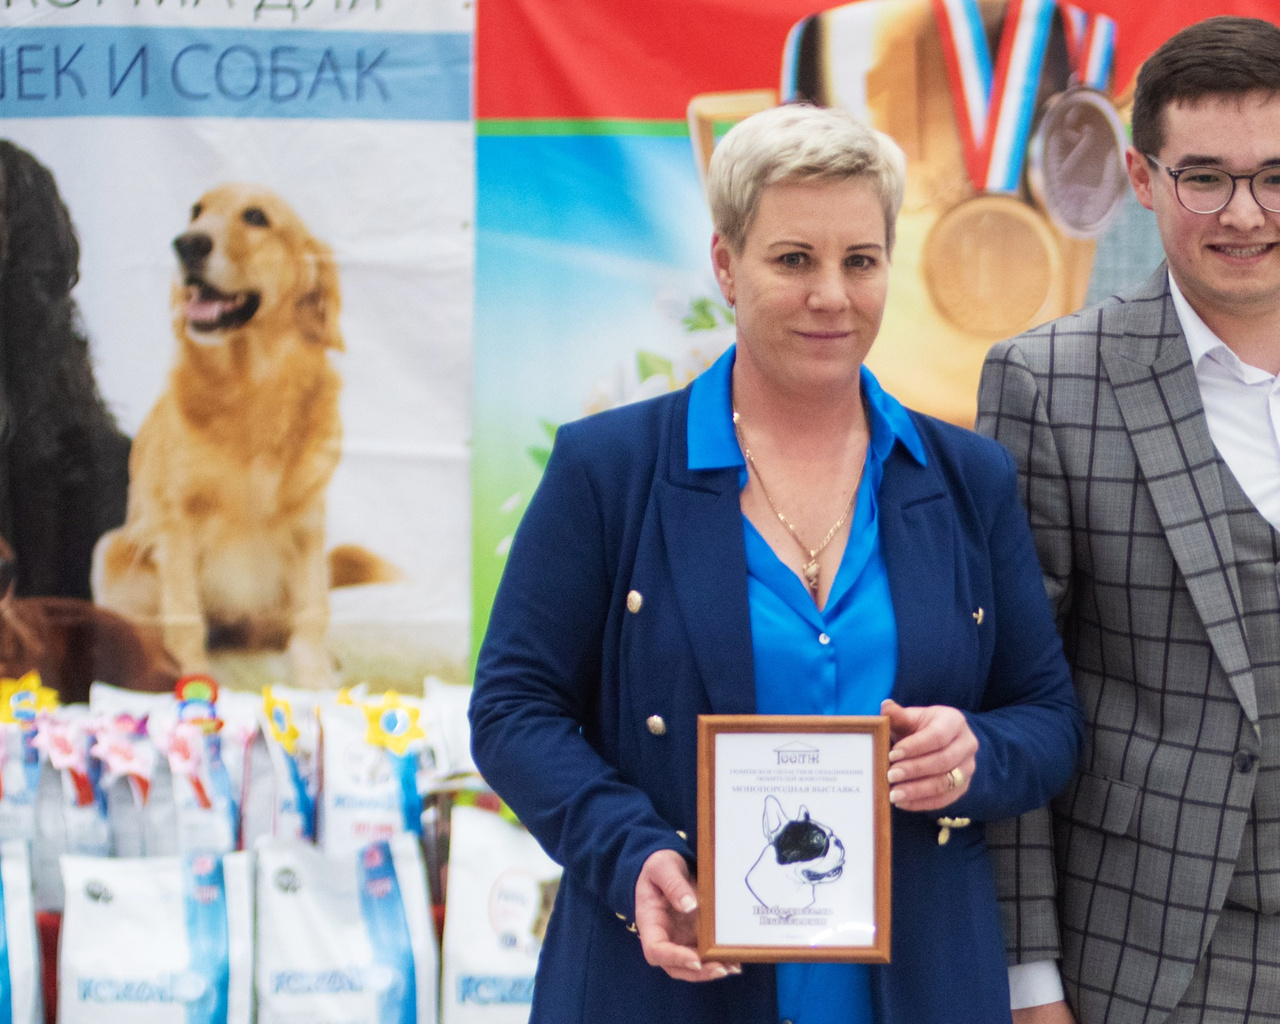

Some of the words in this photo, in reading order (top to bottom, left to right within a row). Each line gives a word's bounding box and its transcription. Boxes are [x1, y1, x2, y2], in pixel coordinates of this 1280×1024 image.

[0, 44, 87, 100] ЕК
[108, 43, 148, 100] И
[170, 43, 391, 102] СОБАК
